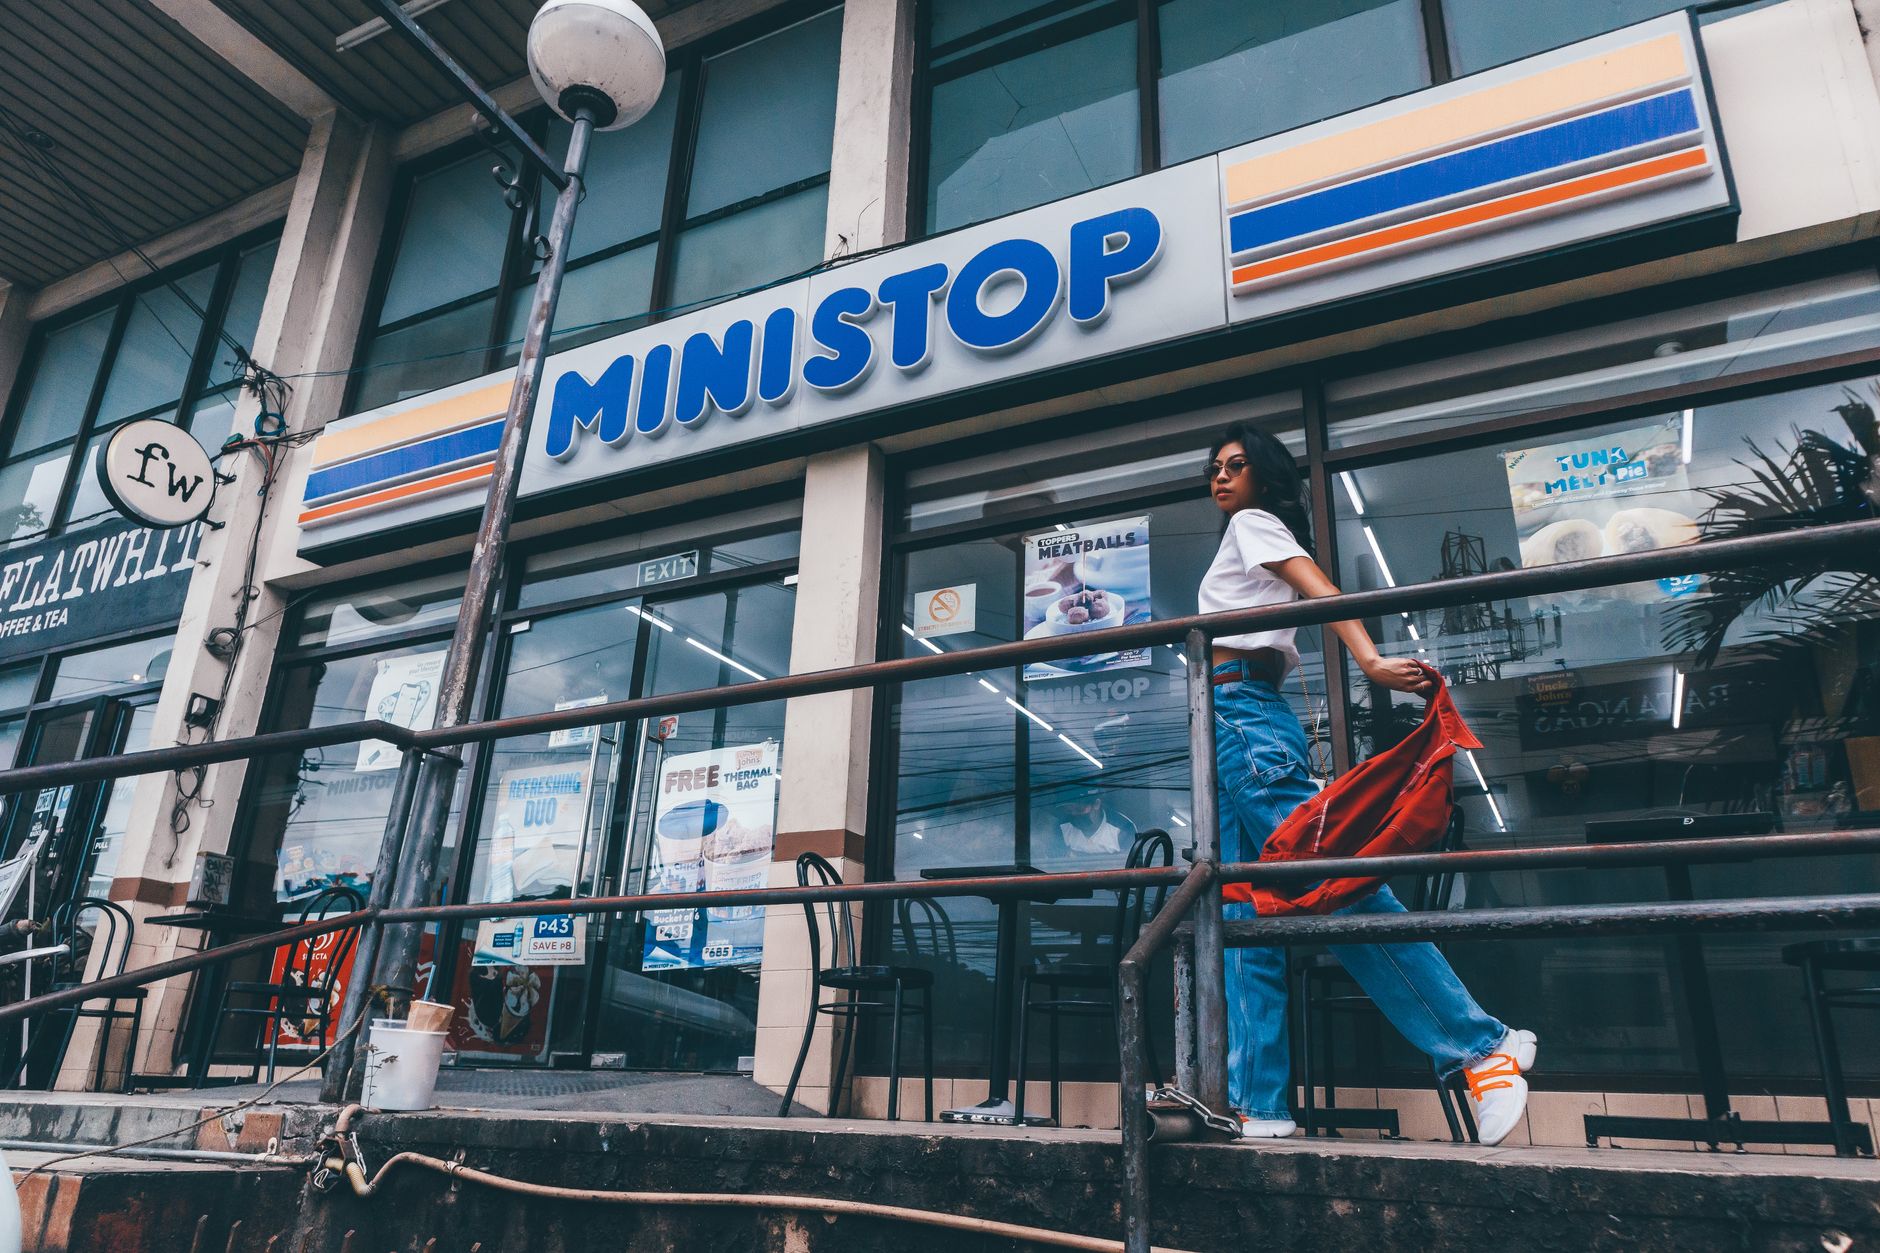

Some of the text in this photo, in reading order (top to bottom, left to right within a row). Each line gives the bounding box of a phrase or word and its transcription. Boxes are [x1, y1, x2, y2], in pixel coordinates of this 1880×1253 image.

[545, 207, 1164, 462] MINISTOP
[1554, 446, 1630, 472] TUNA
[127, 442, 204, 503] fw
[1616, 464, 1645, 482] Pie
[1038, 532, 1136, 561] MEATBALLS
[1040, 534, 1077, 546] TOPPERS
[644, 557, 691, 583] EXIT
[32, 614, 41, 632] &
[44, 607, 69, 630] TEA
[509, 772, 581, 799] REFRESHING
[664, 764, 720, 794] FREE
[723, 766, 773, 782] THERMAL
[736, 780, 759, 791] BAG
[524, 797, 558, 828] DUO
[95, 841, 109, 850] PULL
[653, 911, 700, 924] Bucket of 6
[302, 953, 328, 961] SECTA
[532, 941, 557, 951] SAVE
